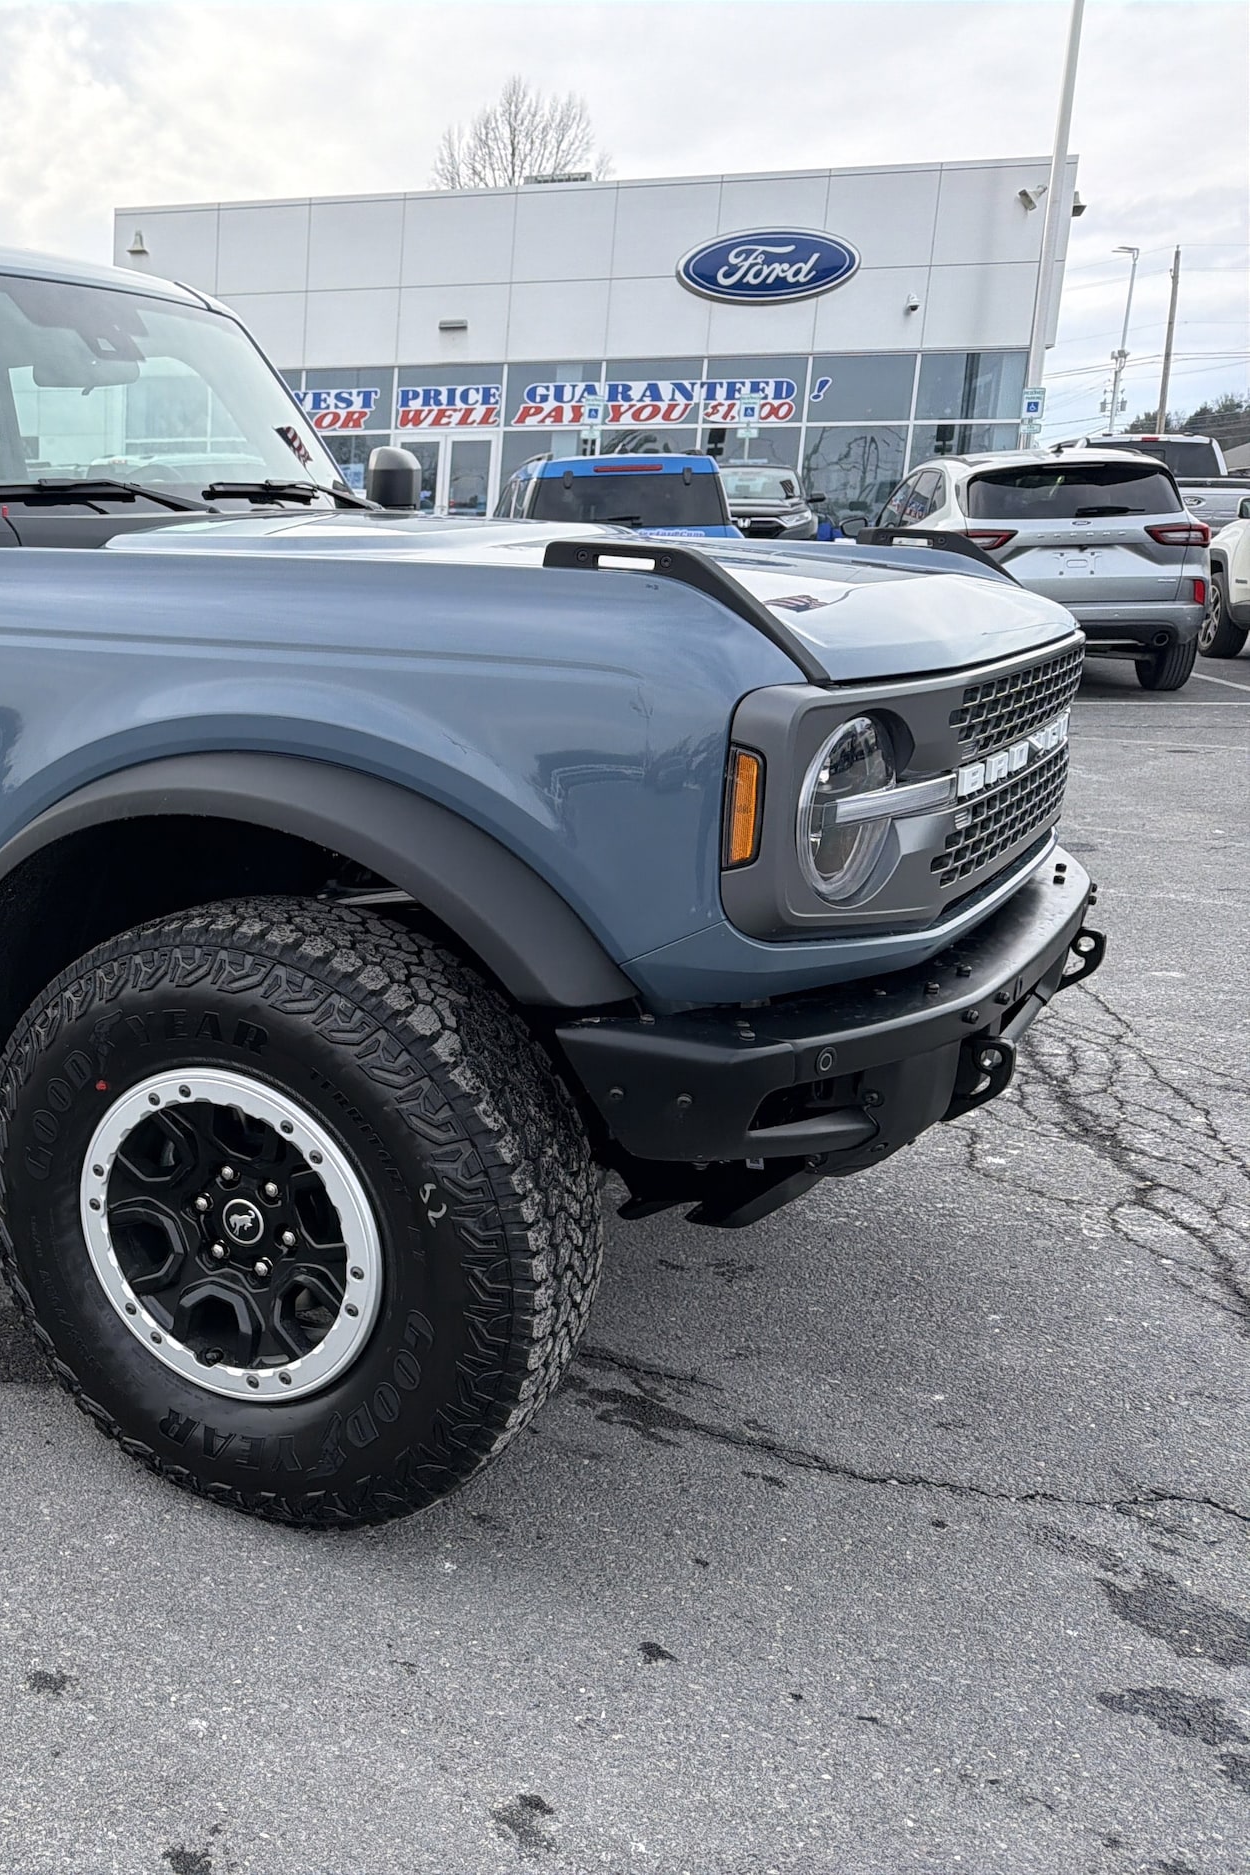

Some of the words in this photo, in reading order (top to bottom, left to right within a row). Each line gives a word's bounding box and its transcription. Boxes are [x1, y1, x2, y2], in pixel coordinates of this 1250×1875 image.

[716, 244, 821, 286] Ford
[399, 386, 500, 408] PRICE
[525, 380, 796, 404] GUARANTEED
[313, 410, 369, 430] OR
[513, 404, 584, 424] PAY
[607, 403, 693, 423] YOU
[703, 401, 794, 421] $1,00
